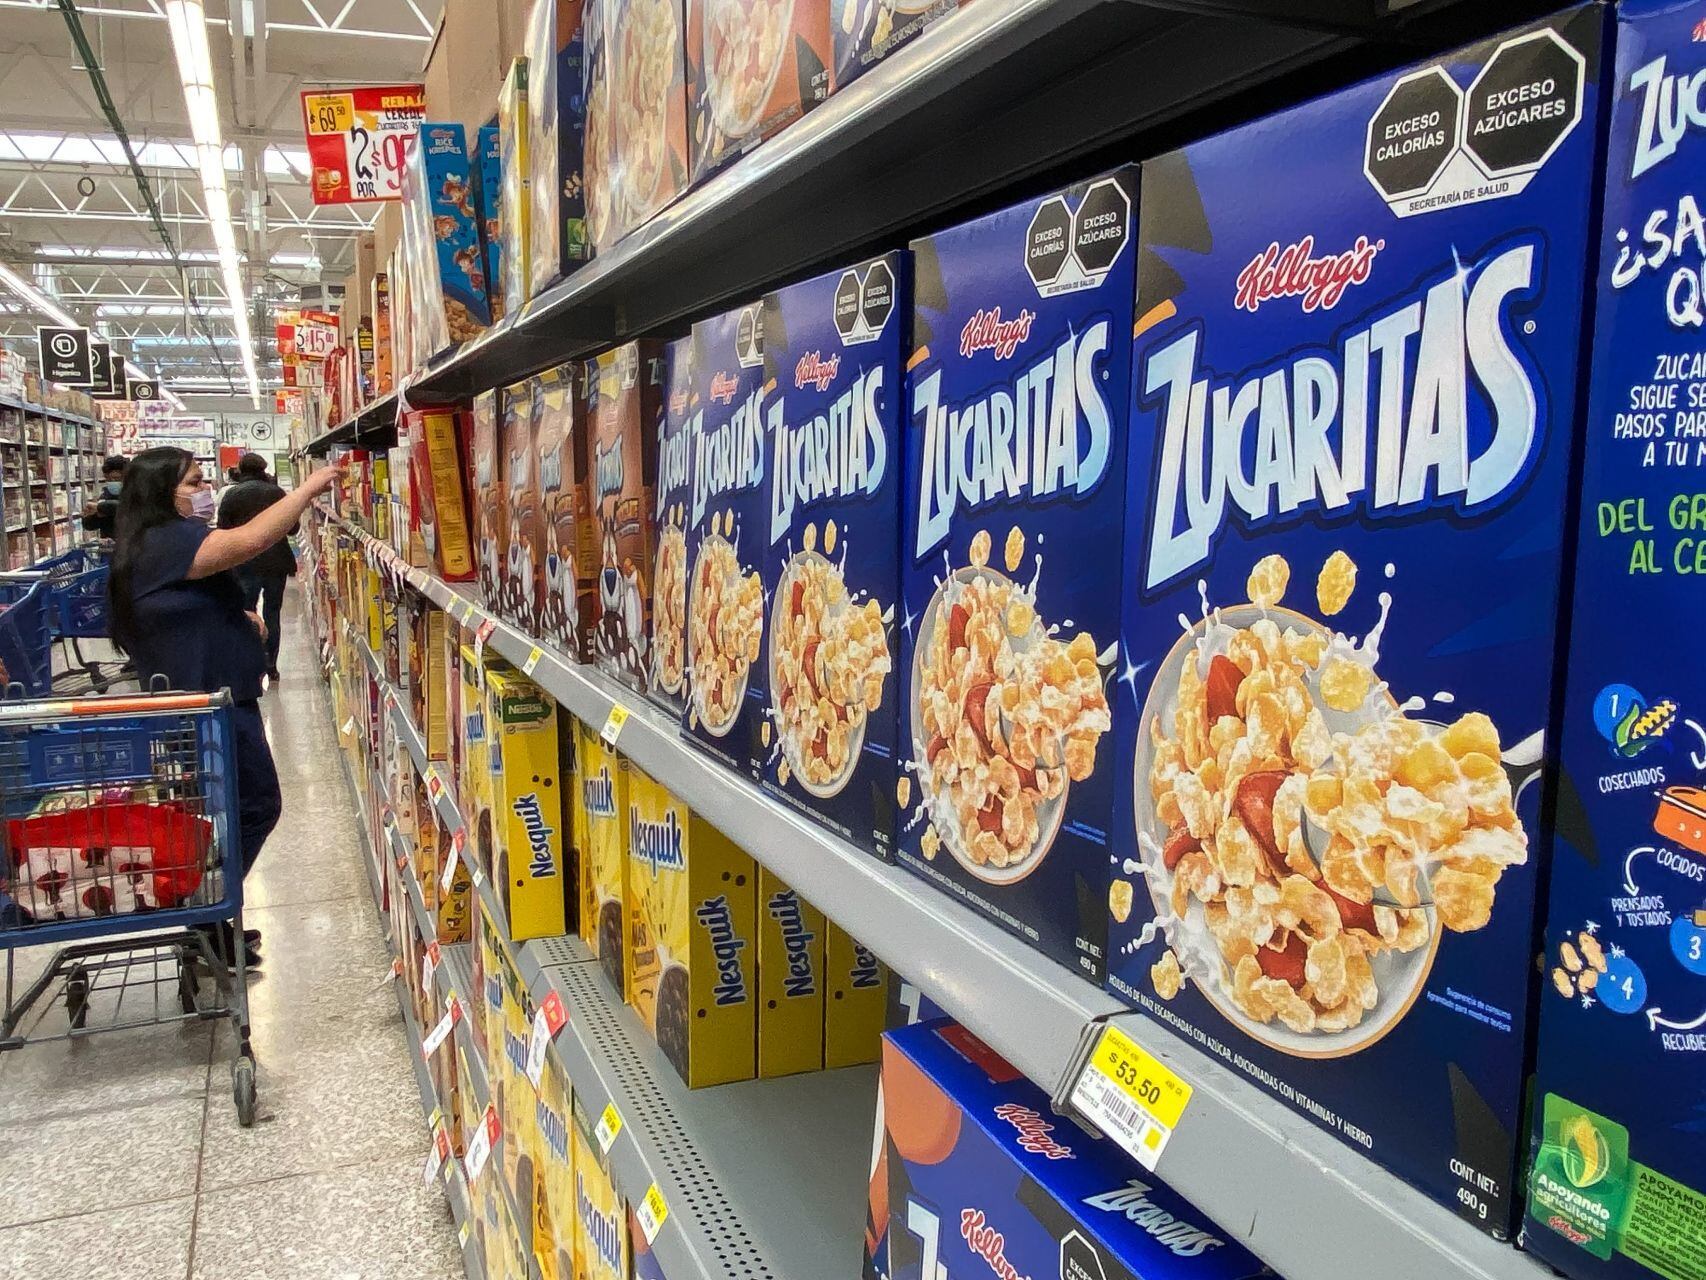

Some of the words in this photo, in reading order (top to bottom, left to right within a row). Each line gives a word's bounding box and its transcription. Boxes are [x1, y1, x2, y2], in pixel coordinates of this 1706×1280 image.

[1486, 78, 1555, 112] EXCESO
[1384, 111, 1441, 141] EXCESO
[1474, 98, 1566, 135] AZÚCARES
[1376, 130, 1445, 162] CALORÍAS
[356, 181, 378, 199] POR
[1408, 192, 1461, 212] SECRETARÍA
[1462, 188, 1476, 200] DE
[1477, 181, 1509, 198] SALUD
[1035, 227, 1063, 244] EXCESO
[1078, 225, 1122, 246] AZÚCARES
[1084, 211, 1117, 230] EXCESO
[1030, 240, 1065, 260] CALORÍAS
[1234, 234, 1378, 314] Kellogg's
[1666, 259, 1706, 328] Q
[959, 306, 1031, 360] Kellogg's
[1654, 352, 1706, 381] ZUCA
[1630, 384, 1679, 410] SIGUE
[1145, 244, 1537, 589] ZUCARITAS
[1614, 413, 1667, 439] PASOS
[768, 365, 886, 546] ZUCARITAS
[913, 321, 1111, 559] ZUCARITAS
[1642, 441, 1655, 467] A
[1665, 441, 1689, 466] TU
[692, 385, 764, 531] ZUCARITAS
[1597, 498, 1655, 537] DEL
[1629, 539, 1663, 575] AL
[1598, 766, 1666, 793] COSECHADOS
[512, 793, 556, 878] Nesquik
[630, 804, 686, 881] Nesquik
[1656, 848, 1706, 882] COCIDOS
[1611, 895, 1665, 912] PRENSADOS
[1616, 914, 1623, 928] Y
[1626, 910, 1673, 927] TOSTADOS
[697, 896, 747, 1006] Nesquik
[768, 888, 815, 997] Nesquik
[1688, 935, 1701, 961] 3
[1621, 976, 1634, 1001] 4
[1109, 973, 1133, 998] HOJUELAS
[1154, 1004, 1193, 1037] ESCARCHADAS
[1193, 1026, 1207, 1045] CON
[1233, 1055, 1278, 1091] ADICIONADAS
[1279, 1081, 1294, 1101] CON
[1295, 1091, 1336, 1127] VITAMINAS
[1336, 1116, 1343, 1131] Y
[1343, 1121, 1373, 1150] HIERRO
[1109, 1052, 1119, 1064] $
[1116, 1060, 1161, 1105] 53.50
[994, 1104, 1071, 1159] Kellogg's
[1450, 1158, 1476, 1185] CONT.
[1456, 1187, 1478, 1209] 490
[1478, 1203, 1488, 1219] g
[1538, 1174, 1610, 1221] Apoyando
[1640, 1172, 1706, 1211] APOYAMO
[1081, 1179, 1225, 1257] ZUCARITAS
[1536, 1187, 1607, 1233] agricultores
